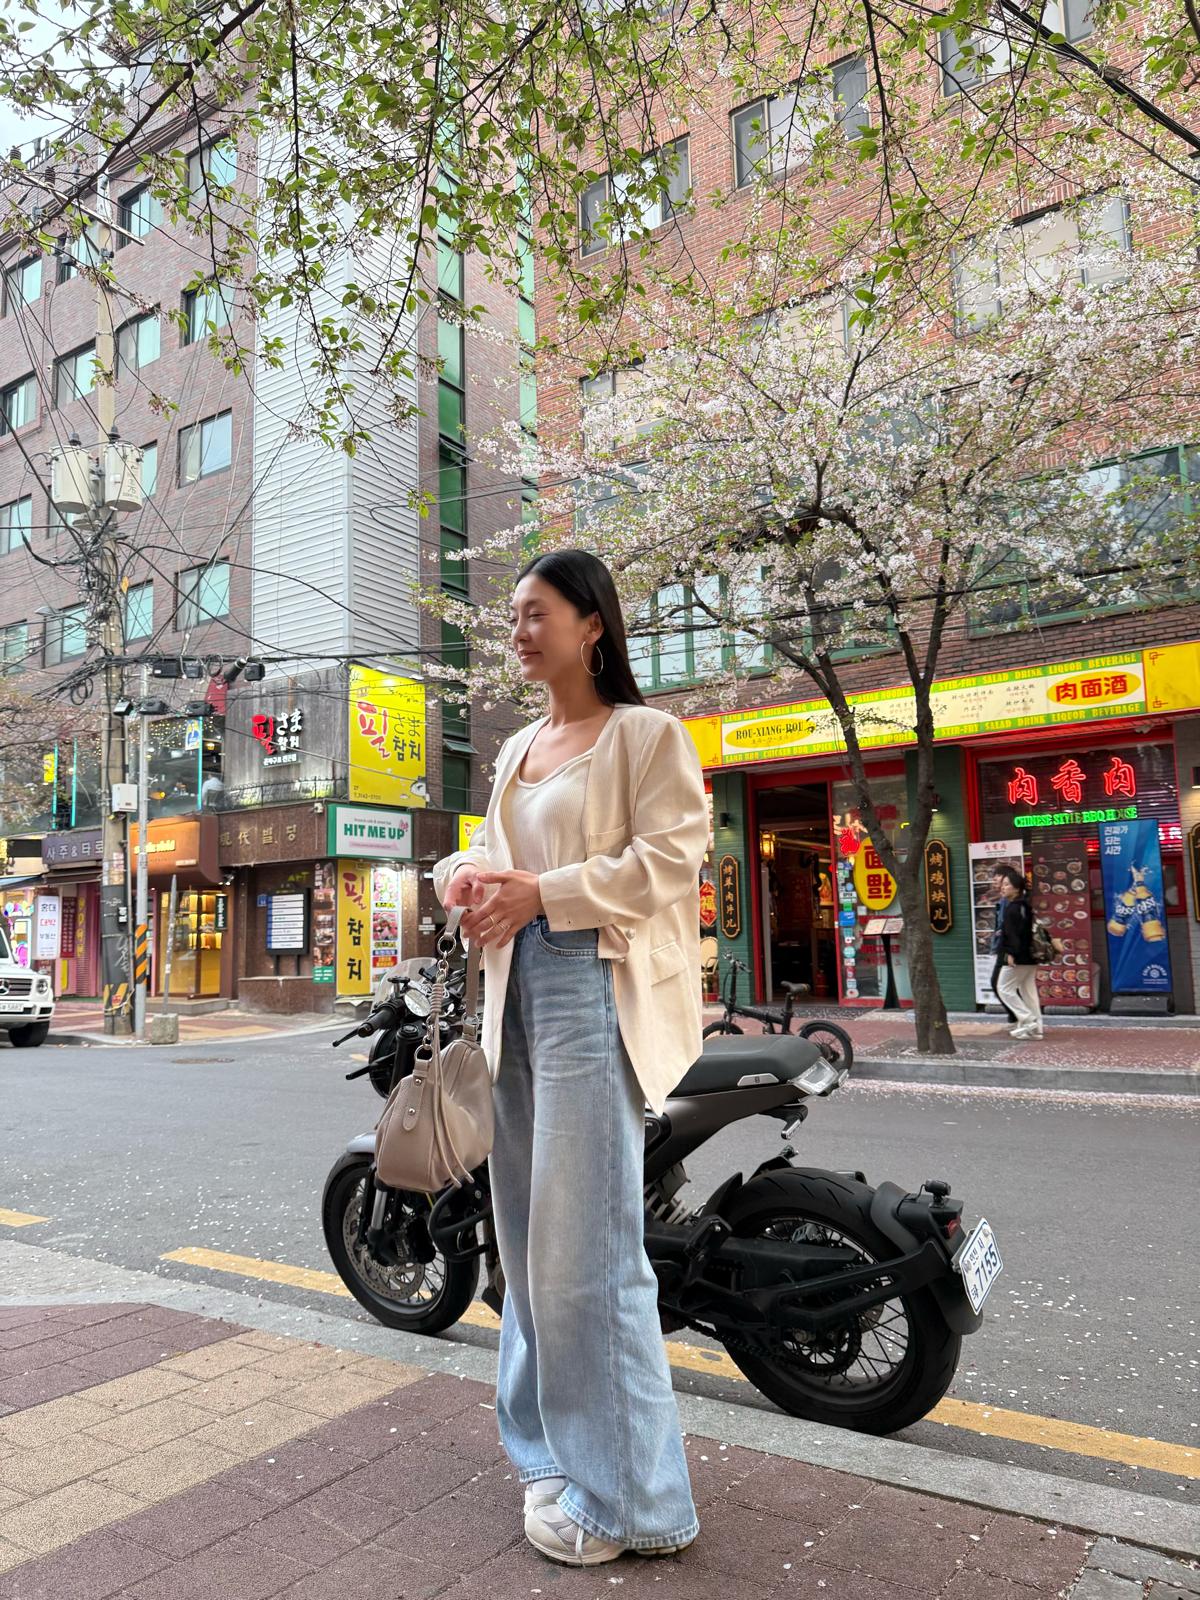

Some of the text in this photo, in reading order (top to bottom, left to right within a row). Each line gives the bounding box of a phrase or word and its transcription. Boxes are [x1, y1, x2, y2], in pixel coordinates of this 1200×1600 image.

[1048, 653, 1137, 674] LIQUOR BEVERAGE
[939, 668, 1042, 689] STIR-FRY SALAD DRINK
[1056, 675, 1127, 702] 肉面酒
[1052, 703, 1140, 722] LIQUOR BEVERAGE
[251, 714, 275, 755] 필
[358, 701, 390, 758] 필
[941, 715, 1045, 736] STIR-FRY SALAD DRINK
[393, 735, 421, 761] 참치
[1008, 757, 1136, 806] 肉香肉
[1014, 814, 1053, 828] CHINESE
[1053, 812, 1082, 825] STYLE
[1082, 810, 1105, 823] BBQ
[344, 823, 405, 840] HIT ME UP
[1105, 846, 1121, 855] 시간
[347, 917, 364, 981] 참치
[975, 1242, 998, 1292] 7155
